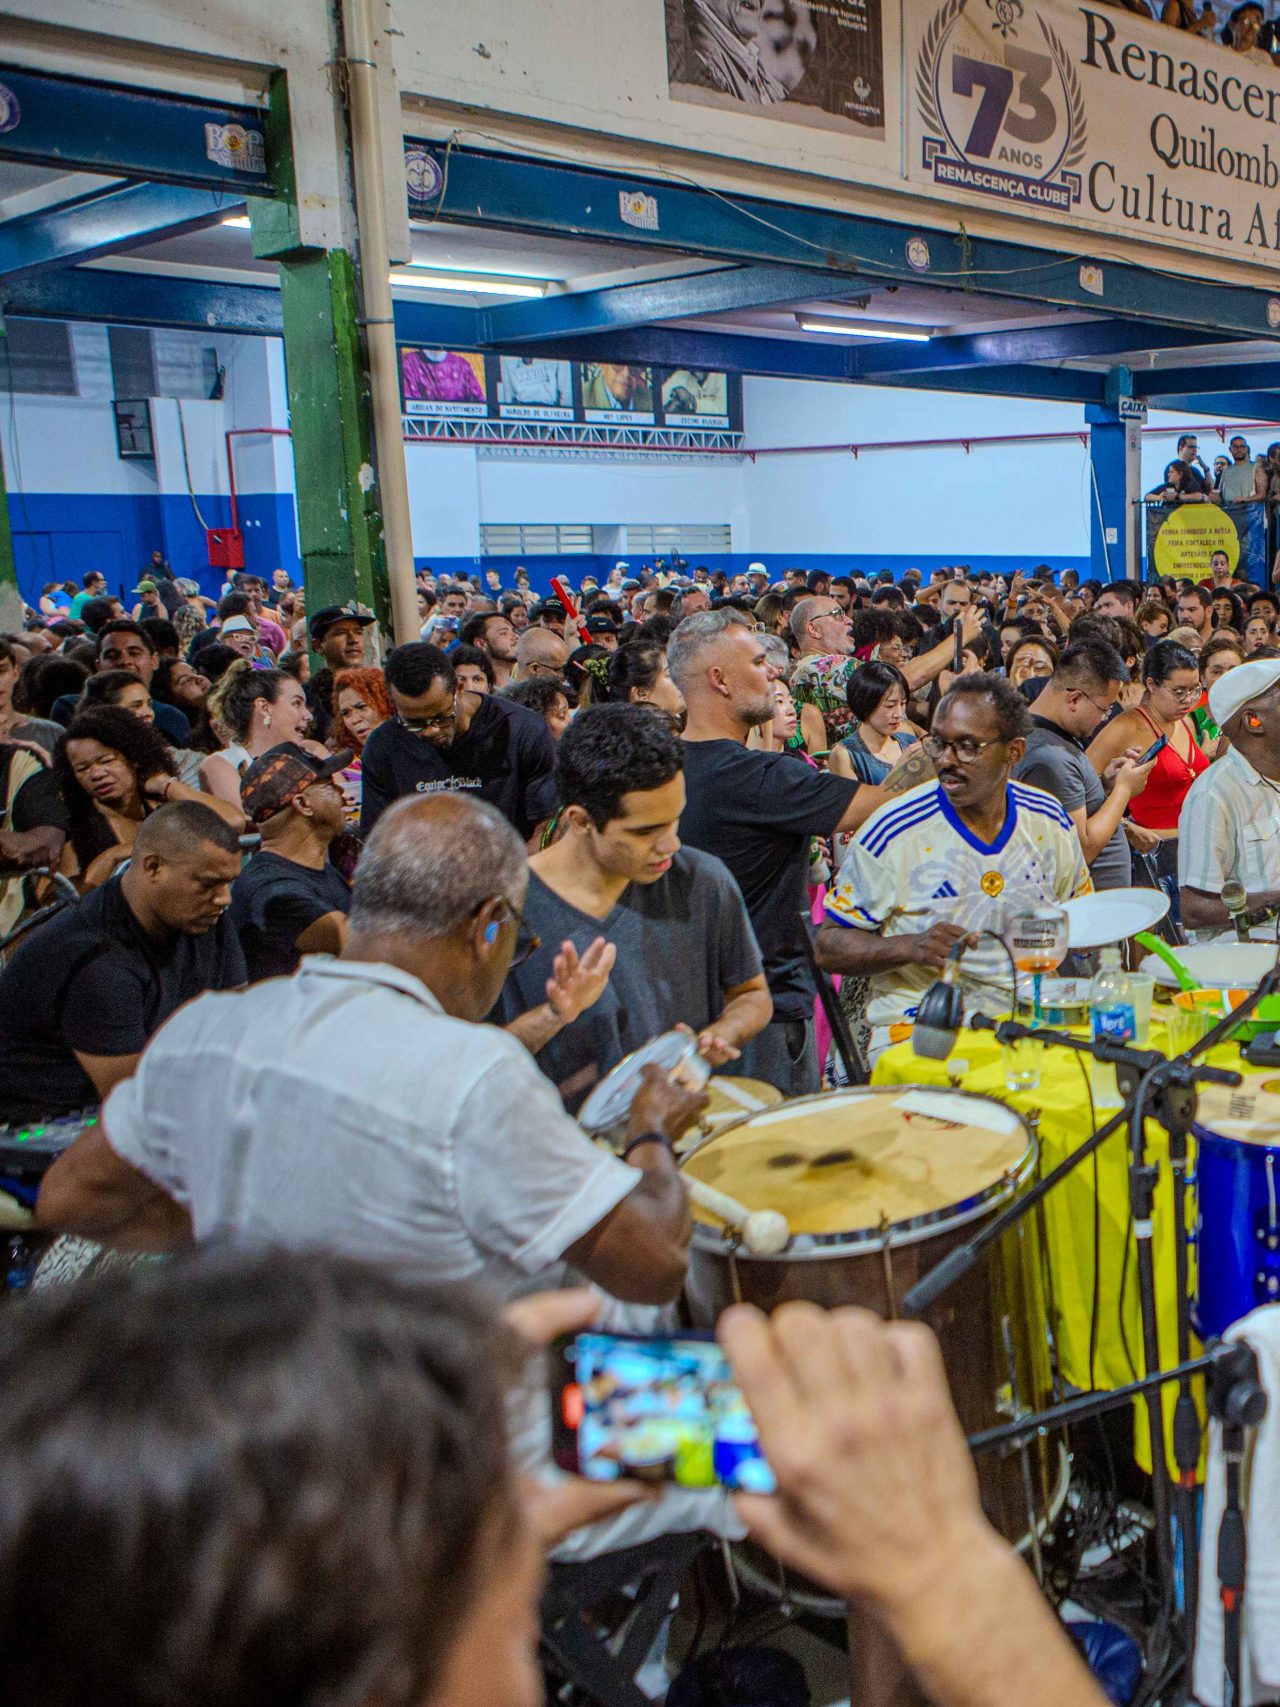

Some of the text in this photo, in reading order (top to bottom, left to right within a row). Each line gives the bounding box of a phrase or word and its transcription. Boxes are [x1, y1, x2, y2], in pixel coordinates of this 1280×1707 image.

[952, 43, 1057, 159] 73
[998, 146, 1043, 169] ANOS
[937, 165, 1068, 205] RENASCENÇA CLUBE
[1088, 161, 1233, 241] Cultura
[1121, 401, 1148, 413] CAIXA
[459, 776, 482, 788] Black
